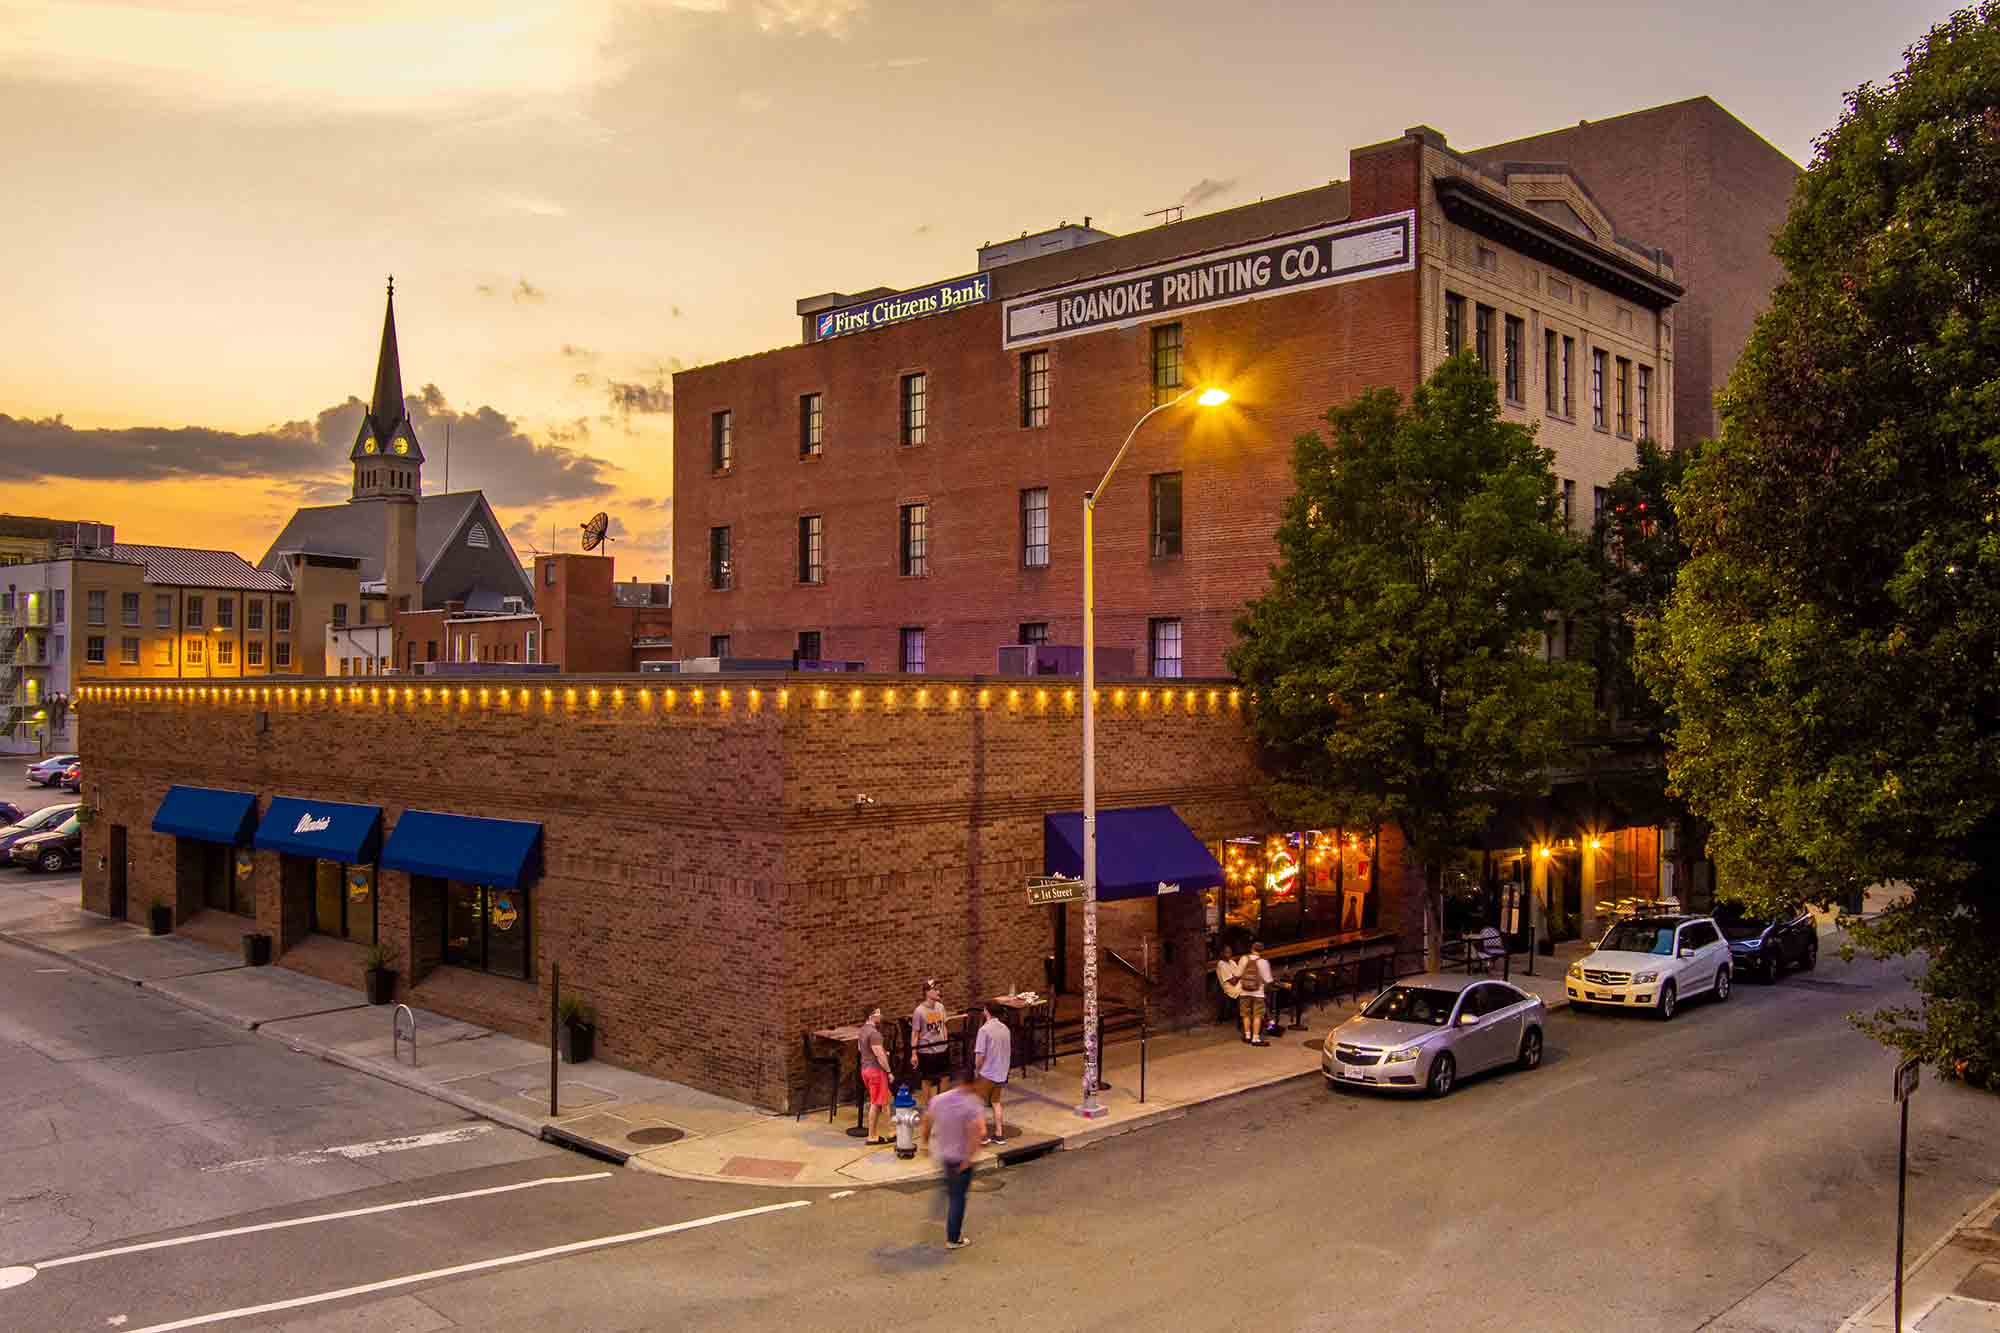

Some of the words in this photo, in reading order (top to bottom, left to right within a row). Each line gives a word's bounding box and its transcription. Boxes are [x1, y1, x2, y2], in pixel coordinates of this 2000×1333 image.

[834, 311, 870, 333] First
[872, 295, 937, 324] Citizens
[940, 280, 986, 309] Bank
[1060, 281, 1153, 327] ROANOKE
[1162, 255, 1271, 301] PRINTING
[1280, 245, 1328, 282] CO.
[1051, 887, 1073, 898] Street
